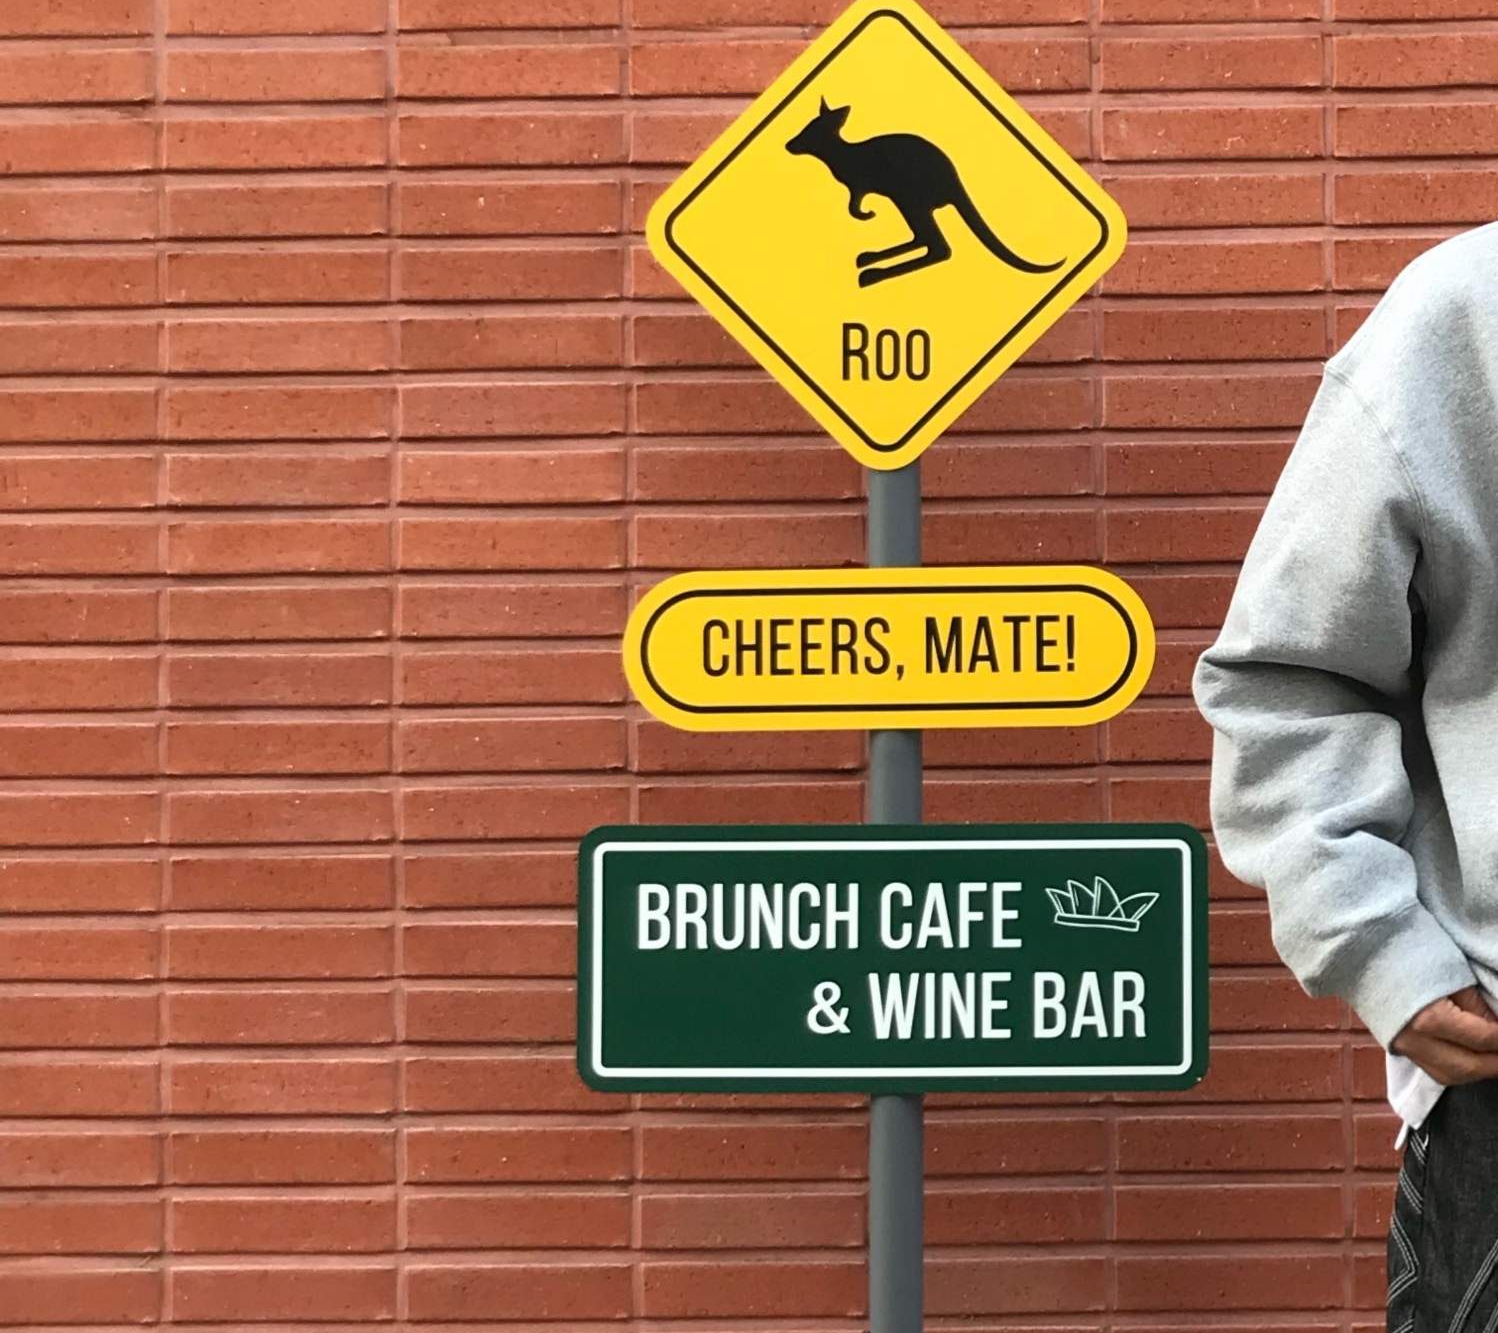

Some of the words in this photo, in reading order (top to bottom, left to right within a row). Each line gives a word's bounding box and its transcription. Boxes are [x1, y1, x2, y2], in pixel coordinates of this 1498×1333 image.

[702, 616, 904, 681] CHEERS,
[925, 614, 1076, 674] MATE!
[637, 882, 859, 950] BRUNCH
[880, 881, 1022, 949] CAFE
[806, 980, 852, 1037] &
[868, 971, 1012, 1040] WINE
[1033, 971, 1146, 1039] BAR
